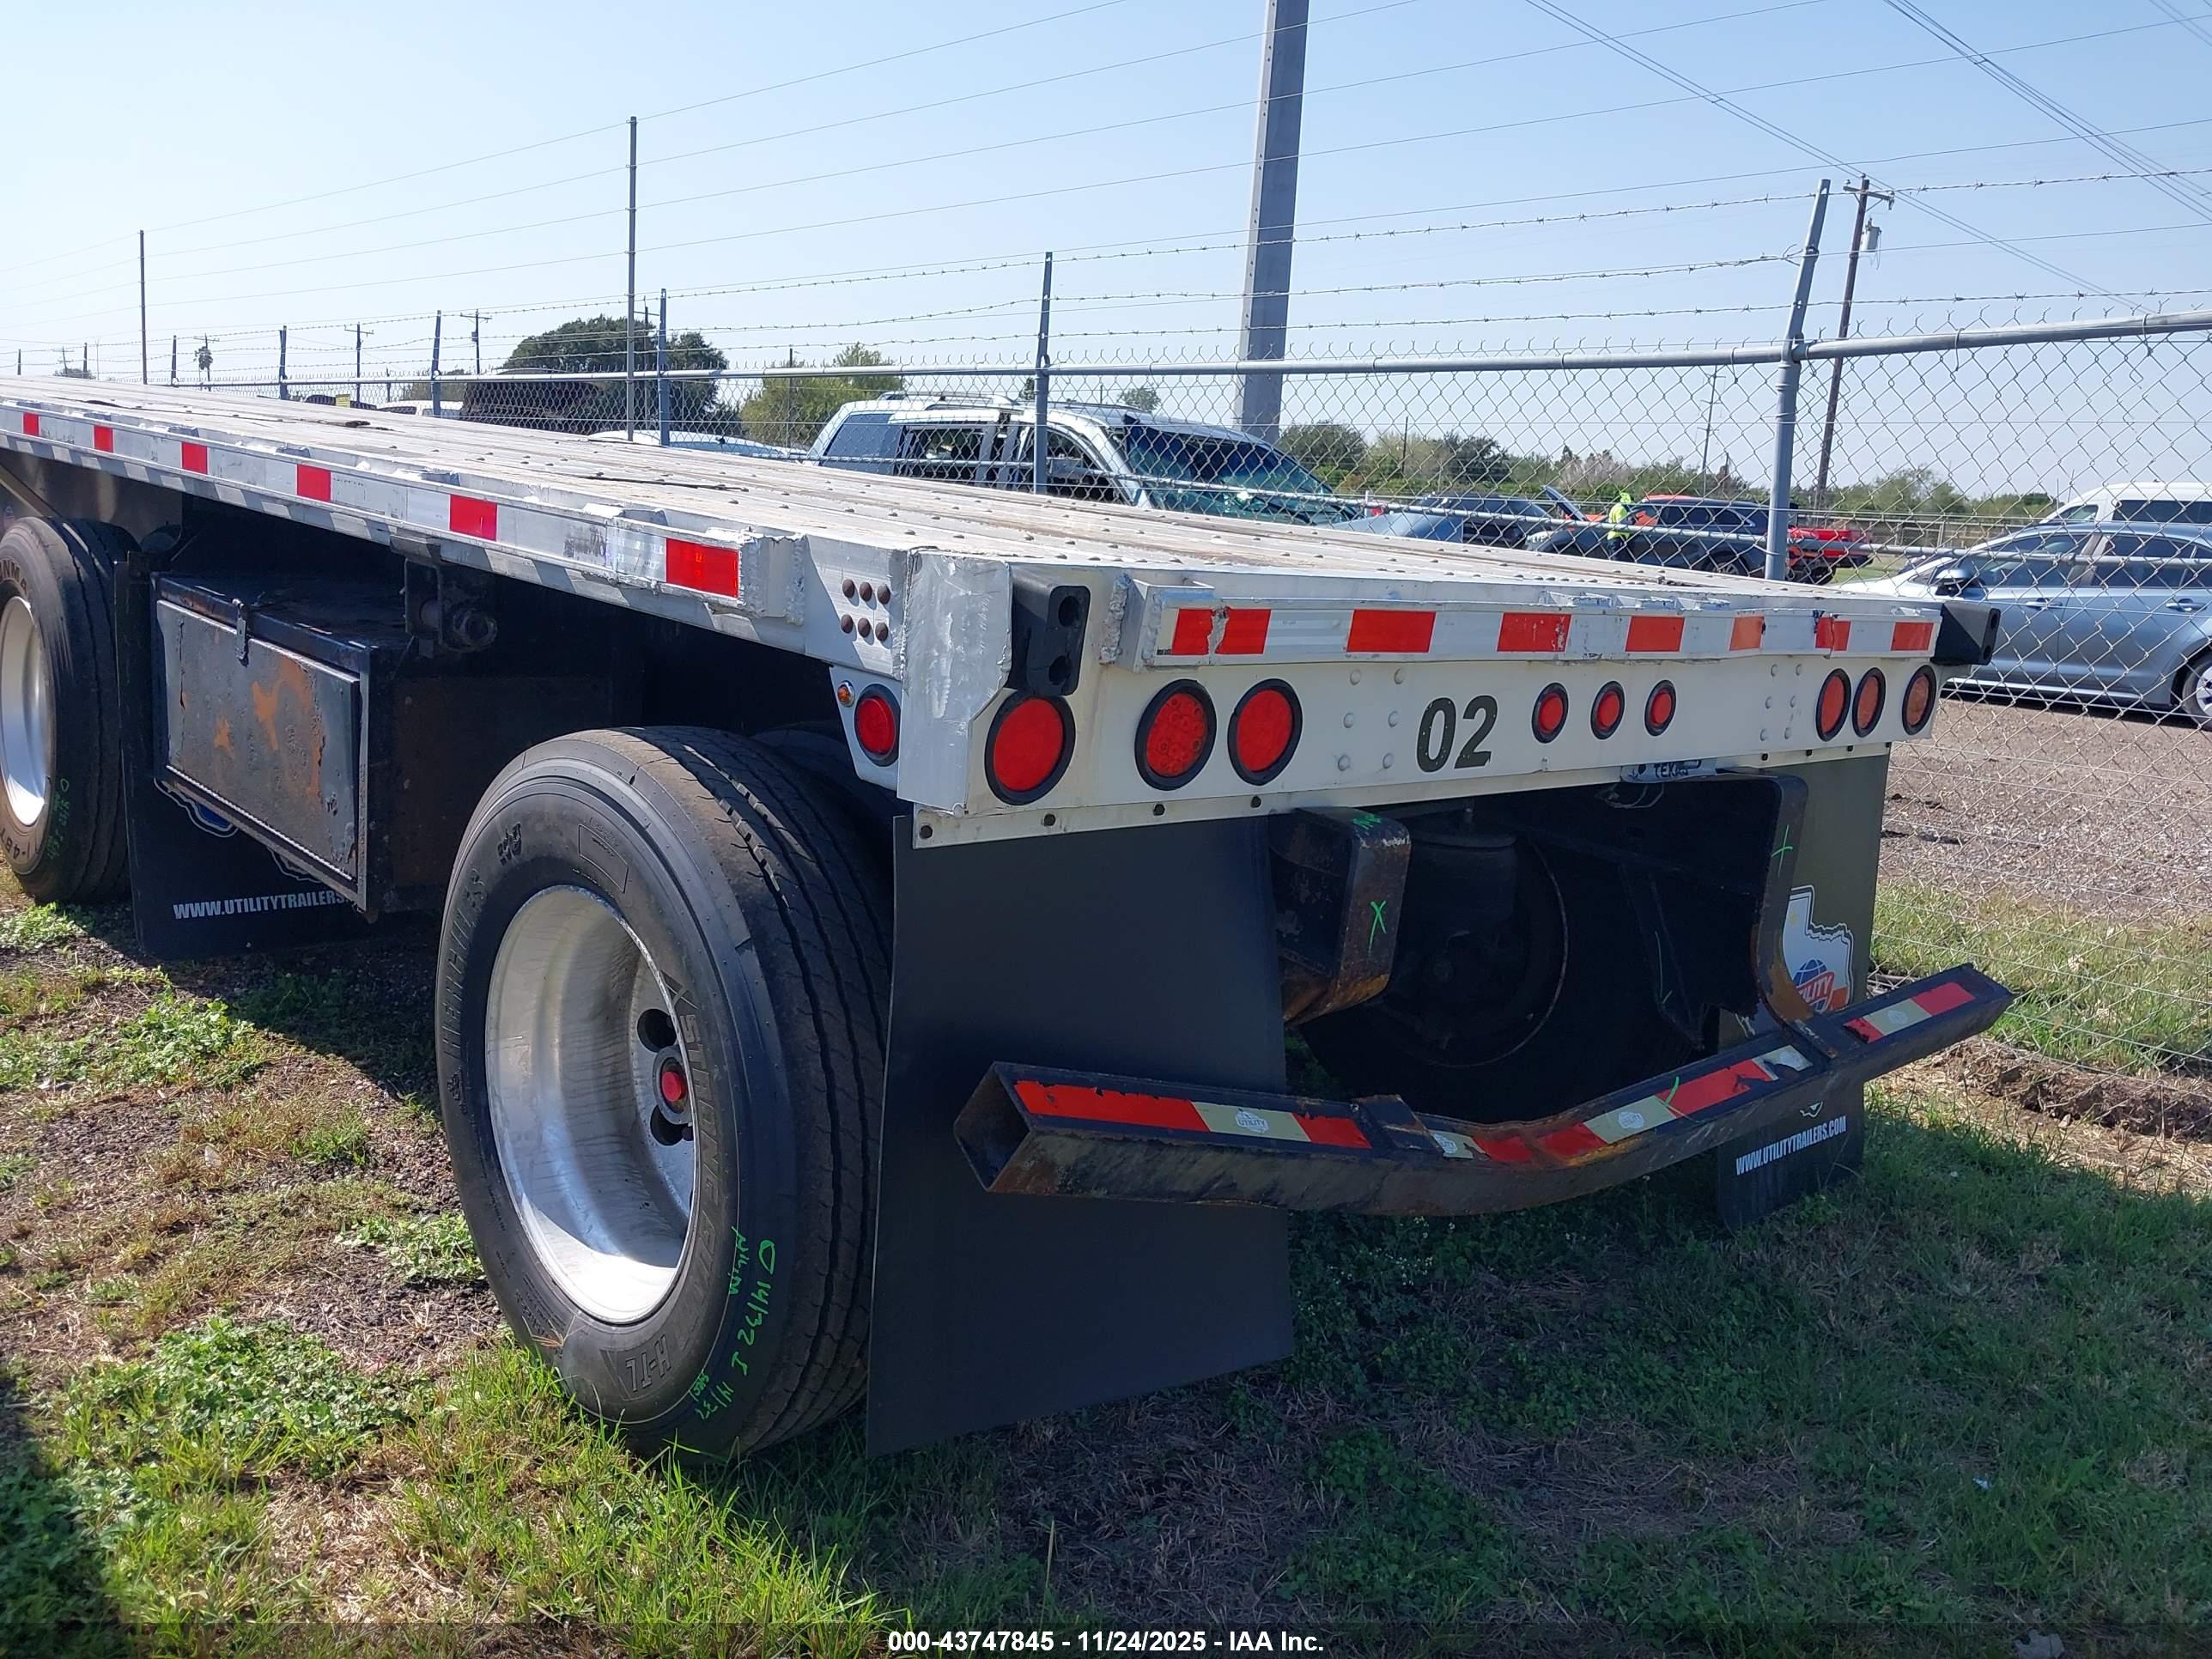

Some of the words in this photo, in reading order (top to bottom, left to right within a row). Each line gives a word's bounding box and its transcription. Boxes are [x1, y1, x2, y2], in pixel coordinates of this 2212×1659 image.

[1416, 695, 1498, 773] 02
[173, 890, 348, 920] WWW.UTILITYTRAILERS.
[1735, 1115, 1847, 1176] WWW.UTILITYTRAILERS.COM
[625, 1333, 672, 1393] H-TL
